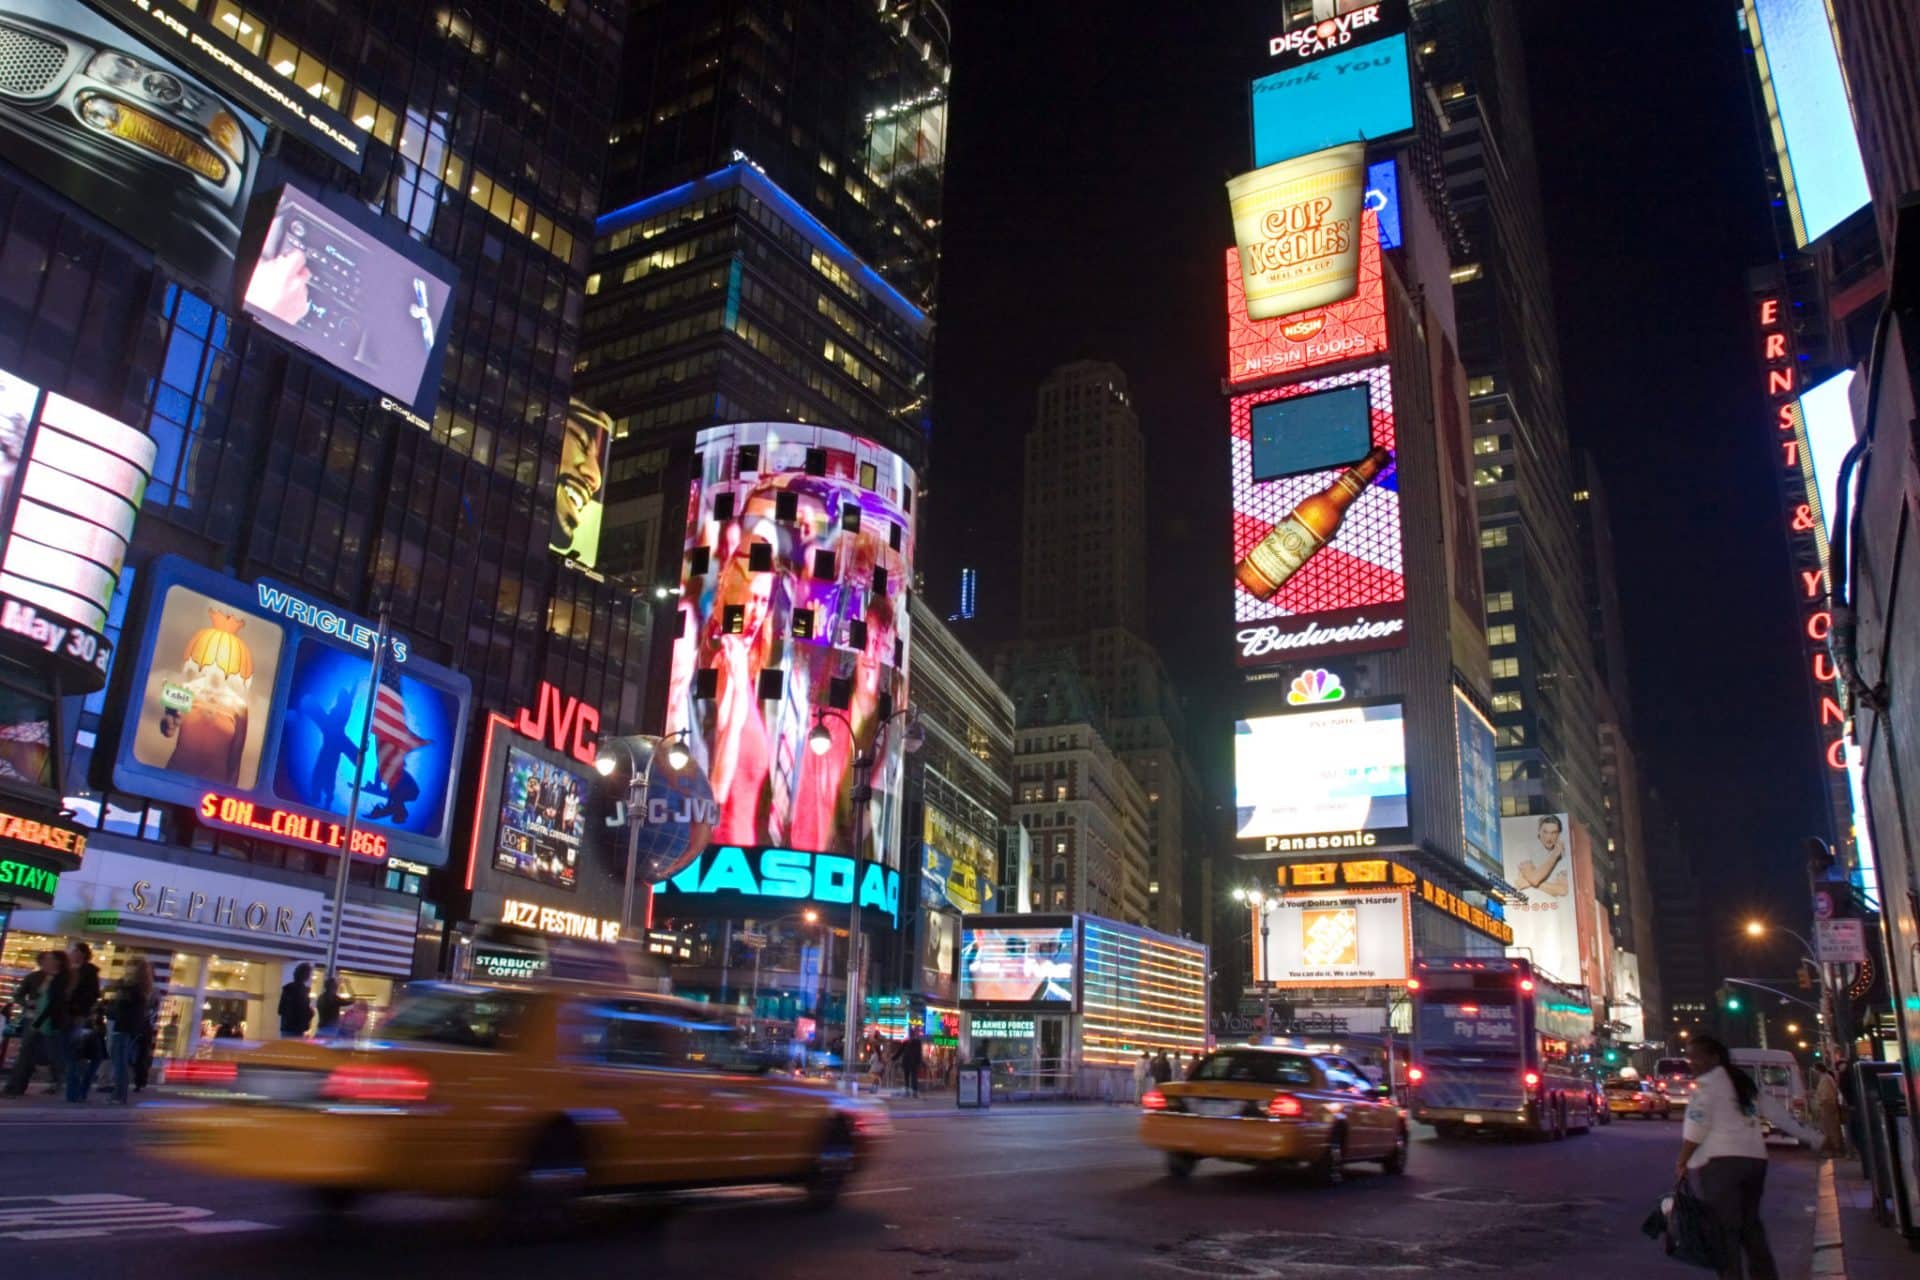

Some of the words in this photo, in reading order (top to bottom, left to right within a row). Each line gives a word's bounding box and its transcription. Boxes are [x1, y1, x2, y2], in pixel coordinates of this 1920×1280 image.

[1269, 6, 1381, 57] DISCOVER
[1298, 31, 1352, 57] CARD
[152, 9, 190, 38] ARE
[191, 33, 306, 119] PROFESSIONAL
[308, 114, 360, 156] GRADE.
[1335, 56, 1392, 75] You
[1260, 196, 1333, 241] CUP
[1284, 319, 1322, 336] NISSIN
[1244, 349, 1301, 372] NISSIN
[1306, 335, 1367, 359] FOODS
[1761, 300, 1799, 467] ERNST
[0, 600, 67, 653] May
[66, 627, 97, 663] 30
[1236, 617, 1405, 657] Budweiser
[519, 680, 600, 767] JVC
[605, 797, 668, 828] JC
[674, 797, 719, 826] JVC
[1265, 831, 1377, 852] Panasonic
[652, 846, 899, 930] NASDAQ
[1286, 900, 1307, 909] Your
[1306, 899, 1339, 908] Dollars
[1339, 898, 1364, 906] Work
[1365, 897, 1398, 906] Harder
[127, 879, 318, 939] SEPHORA
[501, 899, 539, 929] JAZZ
[539, 906, 601, 941] FESTIVAL
[487, 966, 533, 979] COFFEE
[1288, 970, 1301, 978] You
[971, 1020, 981, 1029] US
[982, 1020, 1007, 1029] ARMED
[1007, 1020, 1035, 1029] FORCES
[1453, 1021, 1475, 1038] Fly
[1476, 1021, 1517, 1038] Right.
